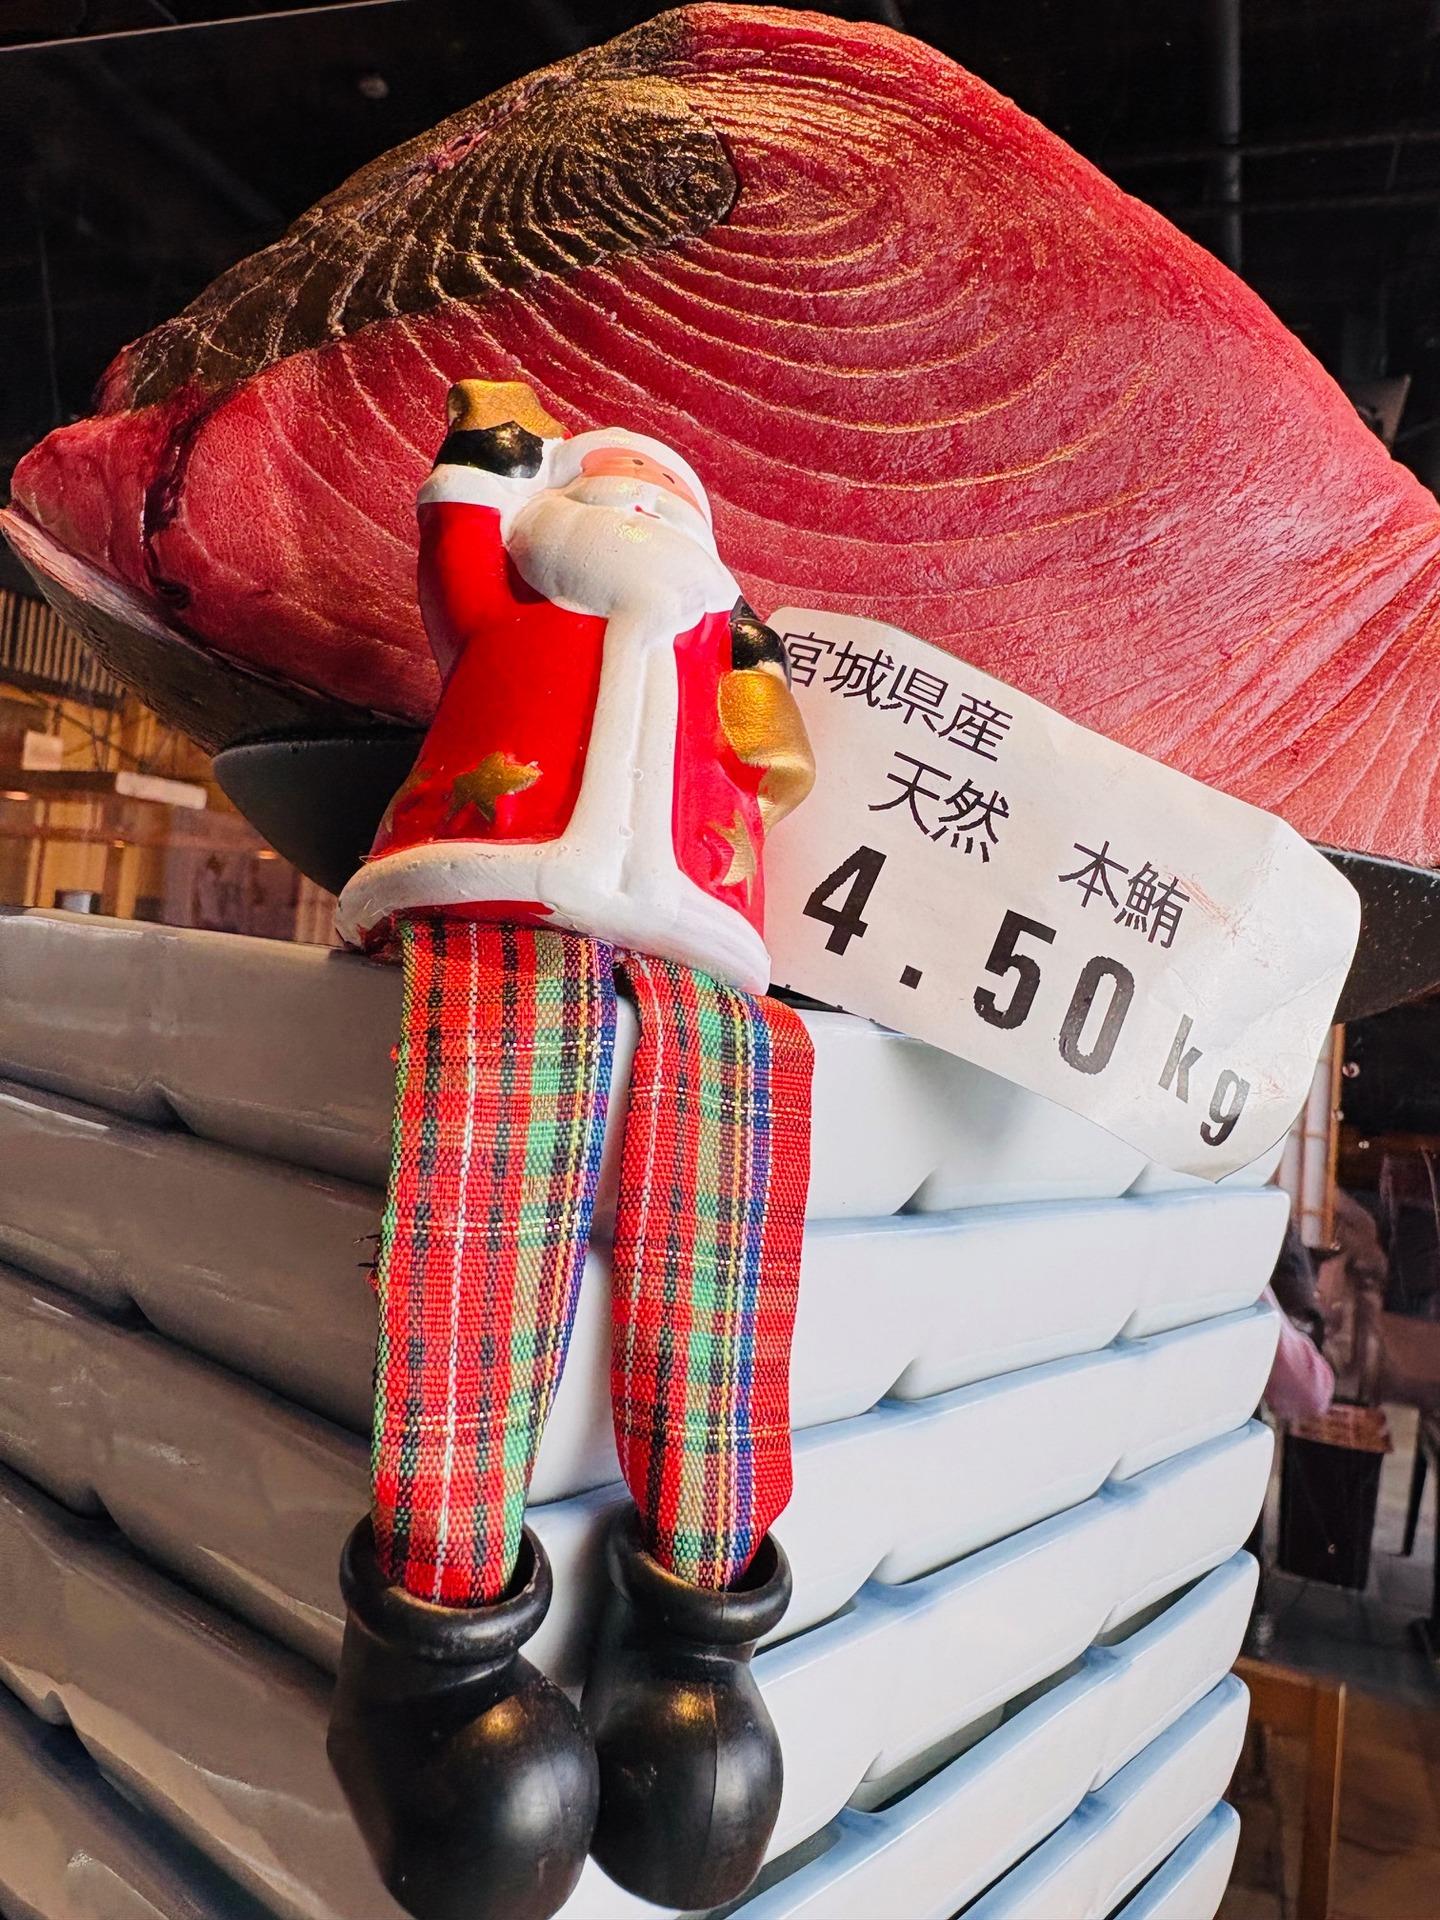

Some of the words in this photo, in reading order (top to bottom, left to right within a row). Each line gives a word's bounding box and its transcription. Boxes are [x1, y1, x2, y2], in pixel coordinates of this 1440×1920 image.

[783, 632, 1012, 763] 宮城県産
[868, 751, 1010, 863] 天然
[1057, 840, 1190, 949] 本鮪
